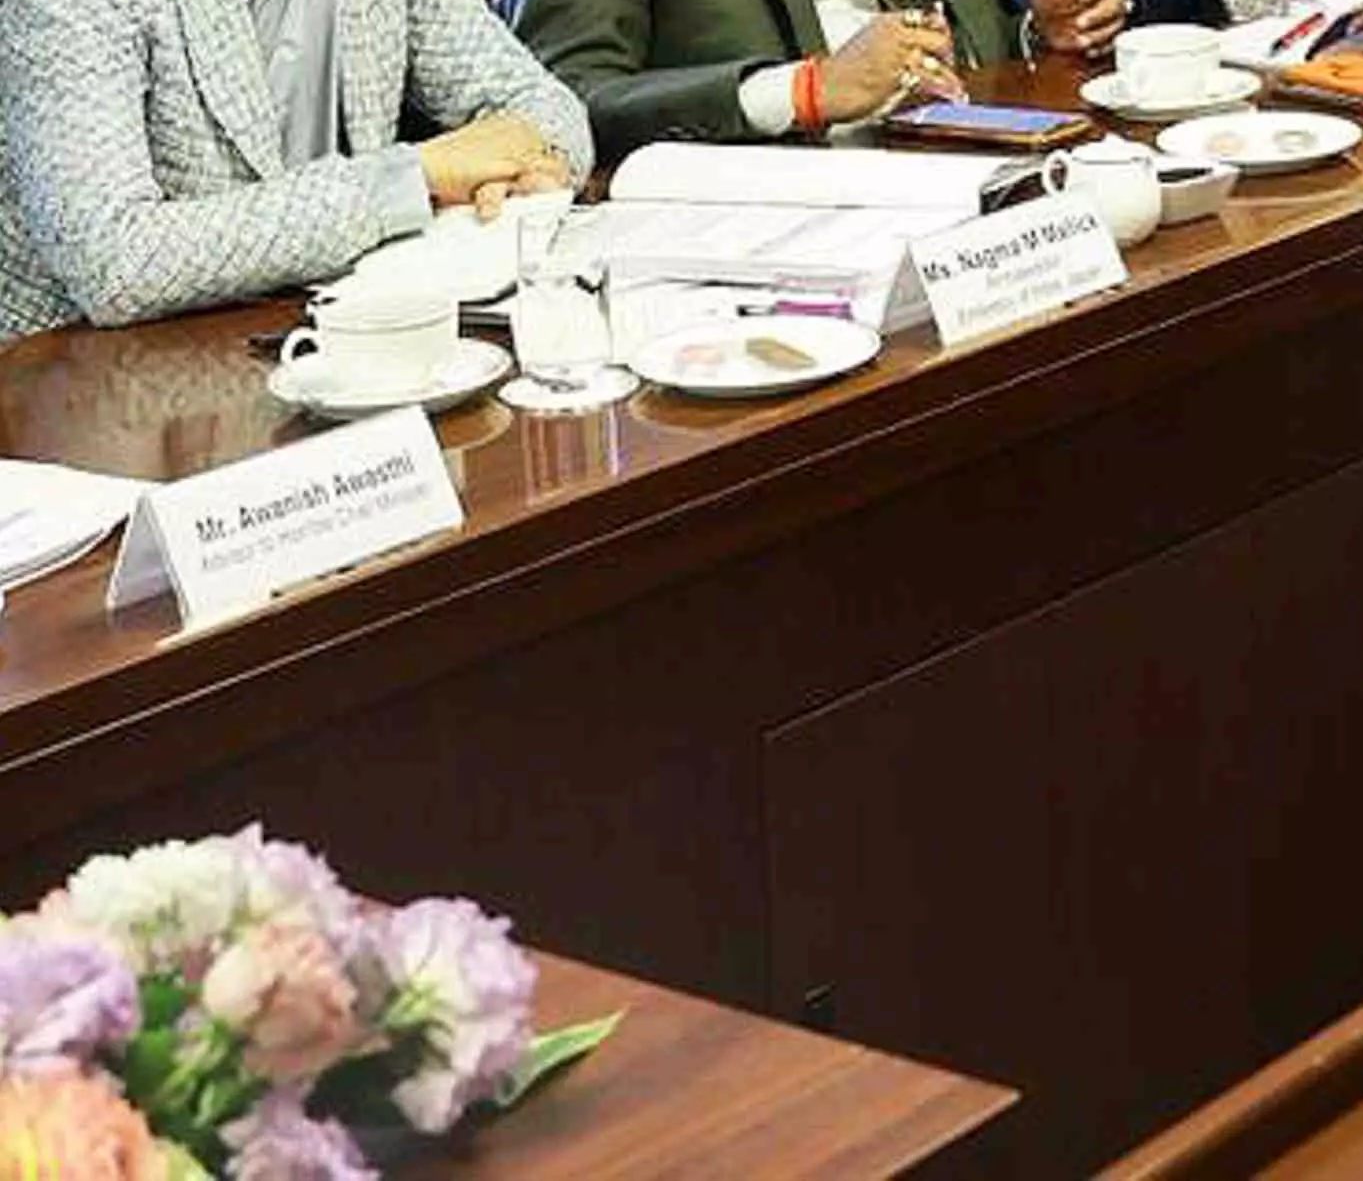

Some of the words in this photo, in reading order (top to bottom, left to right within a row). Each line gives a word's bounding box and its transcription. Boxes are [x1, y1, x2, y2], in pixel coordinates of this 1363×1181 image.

[956, 237, 1021, 271] Nagma
[195, 515, 234, 544] Mr.
[240, 481, 330, 530] Awanish
[333, 451, 415, 497] Awasthi
